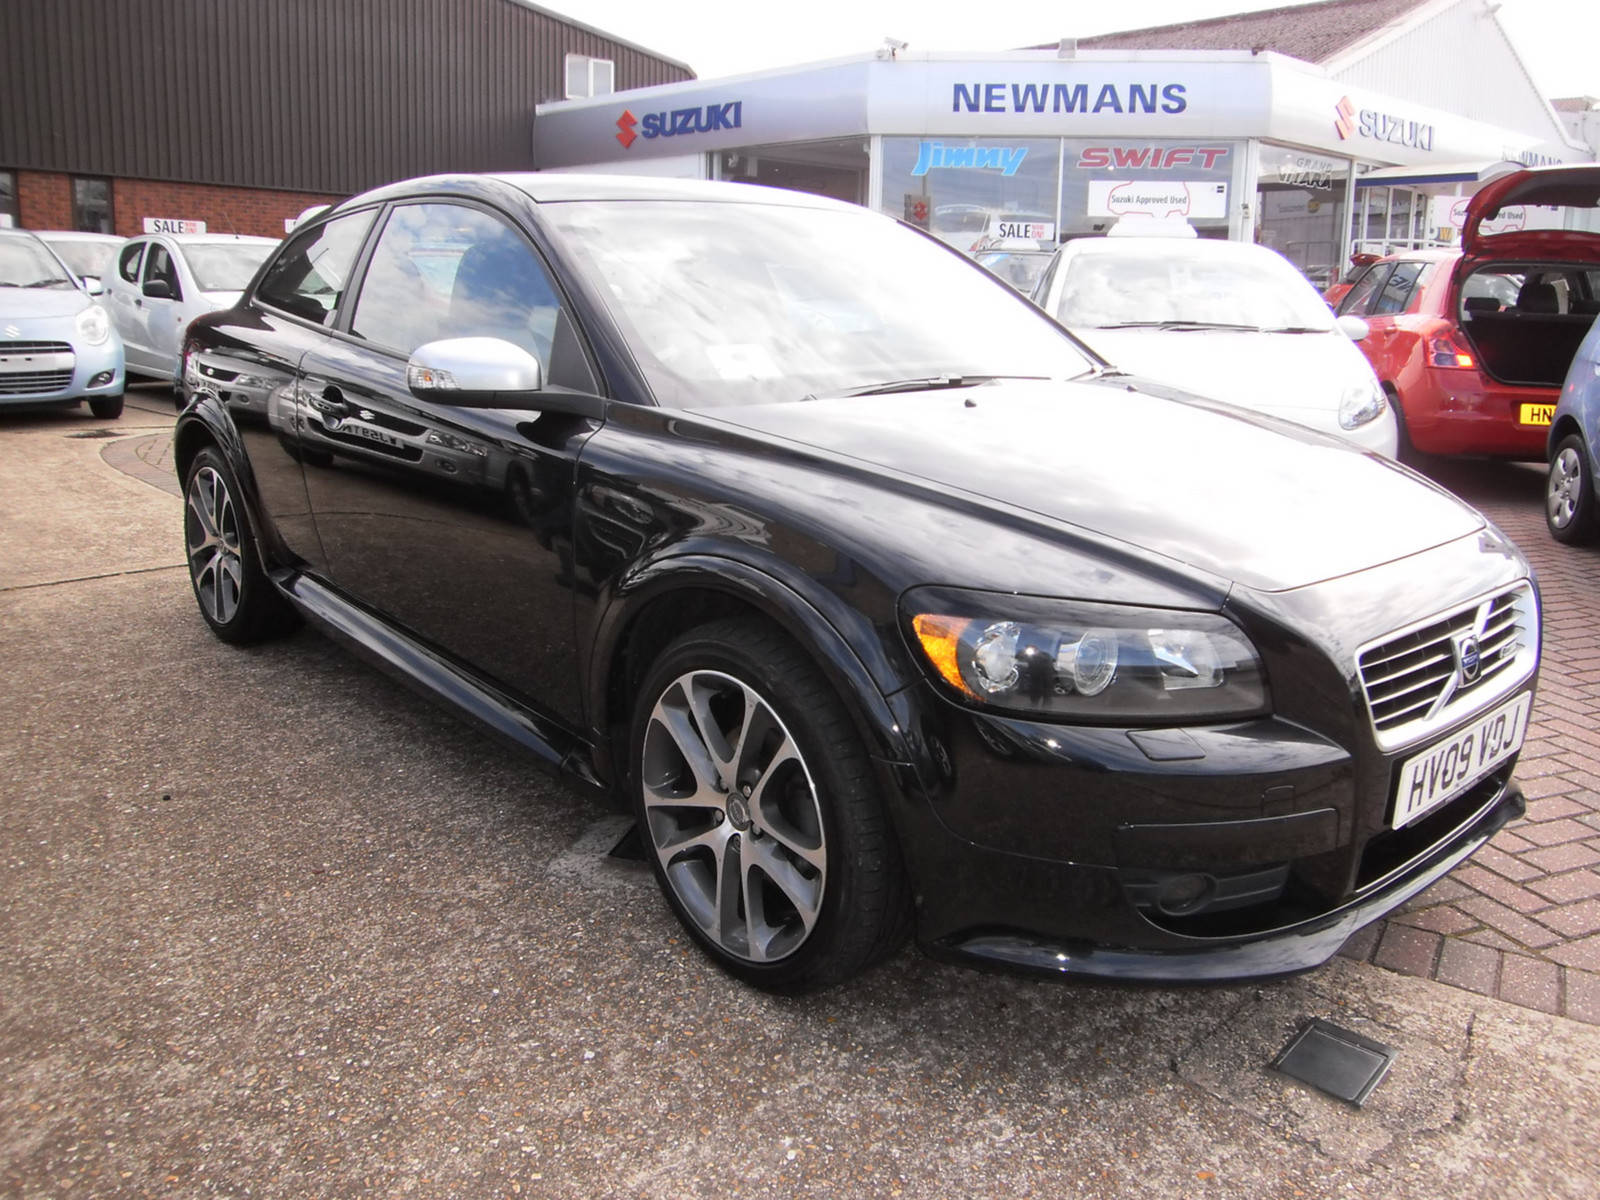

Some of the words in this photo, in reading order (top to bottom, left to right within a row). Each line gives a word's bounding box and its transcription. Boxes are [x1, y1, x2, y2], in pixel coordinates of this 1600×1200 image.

[953, 83, 1187, 114] NEWMANS
[641, 101, 742, 139] SUZUKI
[1359, 109, 1434, 151] SUZUKI
[910, 141, 1029, 176] Jimny
[1077, 147, 1229, 169] SWIFT
[1296, 157, 1334, 173] GRAND
[1279, 171, 1332, 191] VITARA
[1111, 194, 1134, 204] Suzuki
[1135, 195, 1168, 205] Approved
[1169, 196, 1187, 204] Used
[1507, 212, 1523, 220] Used
[154, 219, 184, 234] SALE
[999, 223, 1031, 239] SALE
[1530, 407, 1552, 422] HN
[1408, 733, 1475, 813] HV09
[1479, 704, 1521, 767] VDJ
